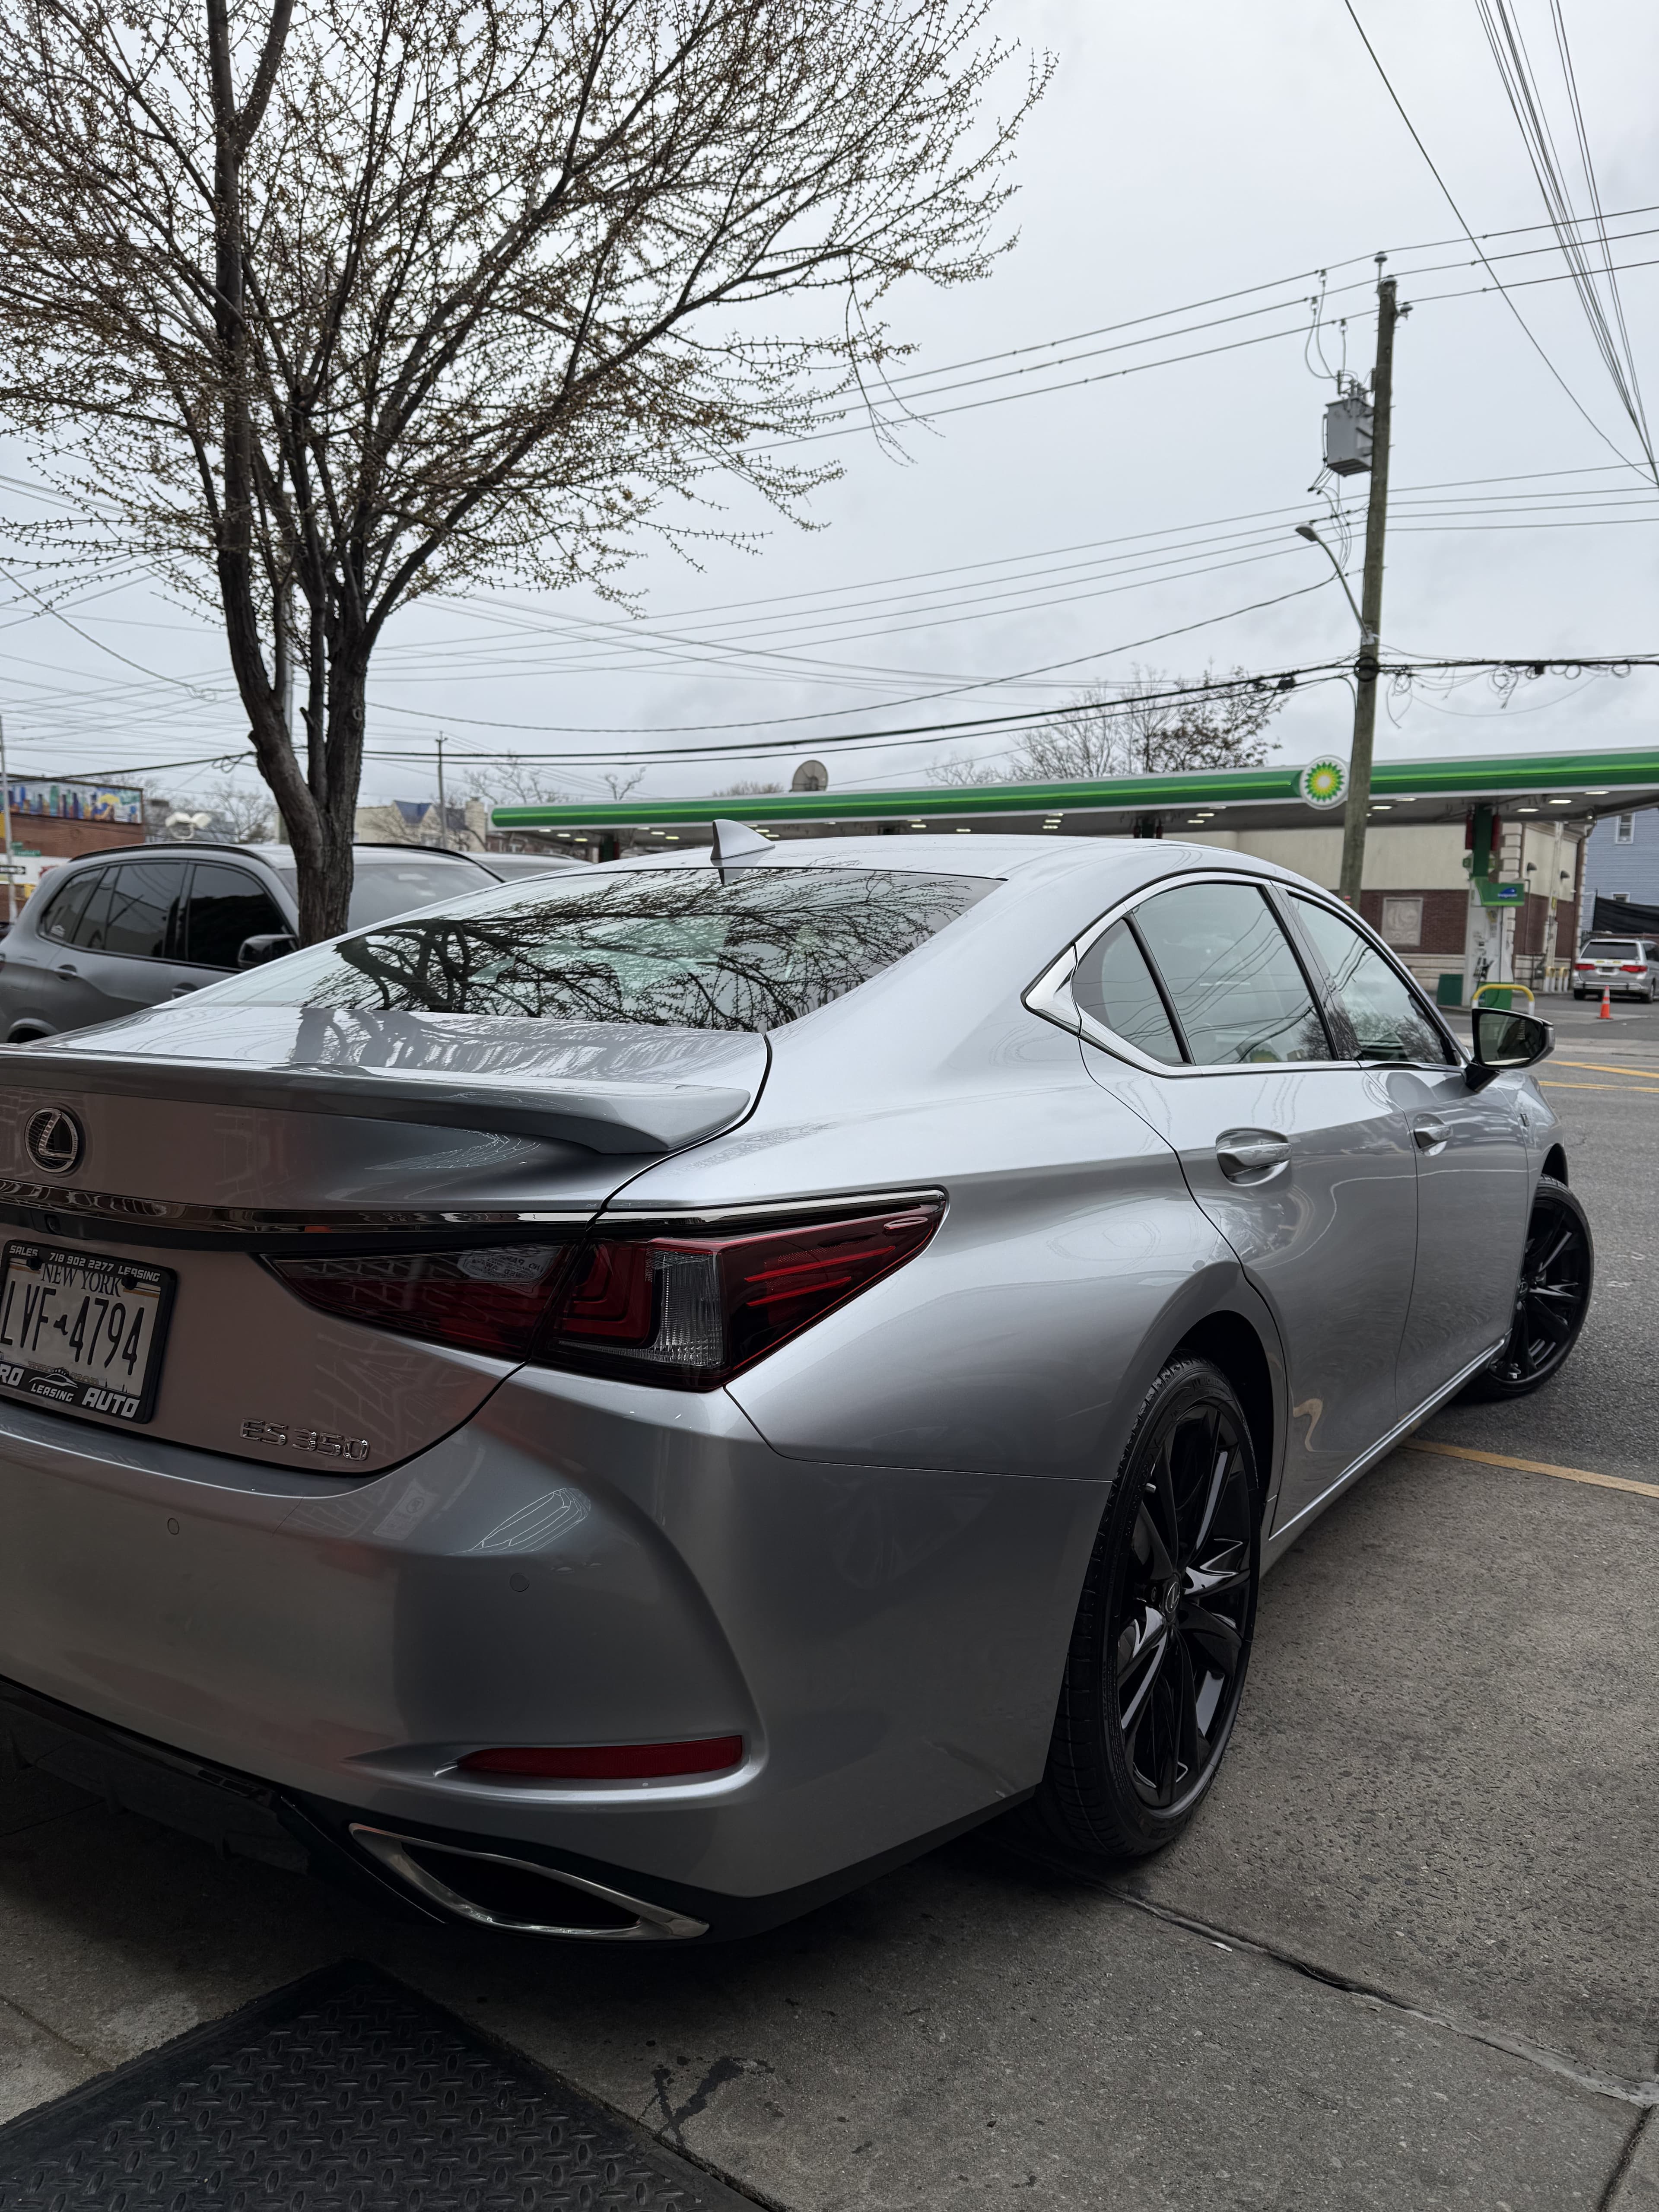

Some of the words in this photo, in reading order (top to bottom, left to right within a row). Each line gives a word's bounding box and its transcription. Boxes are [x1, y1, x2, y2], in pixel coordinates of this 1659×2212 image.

[9, 1245, 38, 1256] SALES
[49, 1253, 64, 1262] 718
[66, 1256, 85, 1267] 902
[88, 1261, 114, 1272] 2277
[118, 1266, 160, 1282] LEASING
[41, 1264, 78, 1289] NEW
[81, 1271, 121, 1297] YORK
[0, 1281, 56, 1351] LVF
[69, 1296, 144, 1375] 4794
[31, 1383, 74, 1402] LEASING
[82, 1387, 141, 1418] AUTO
[240, 1418, 288, 1446] ES
[292, 1427, 370, 1461] 350
